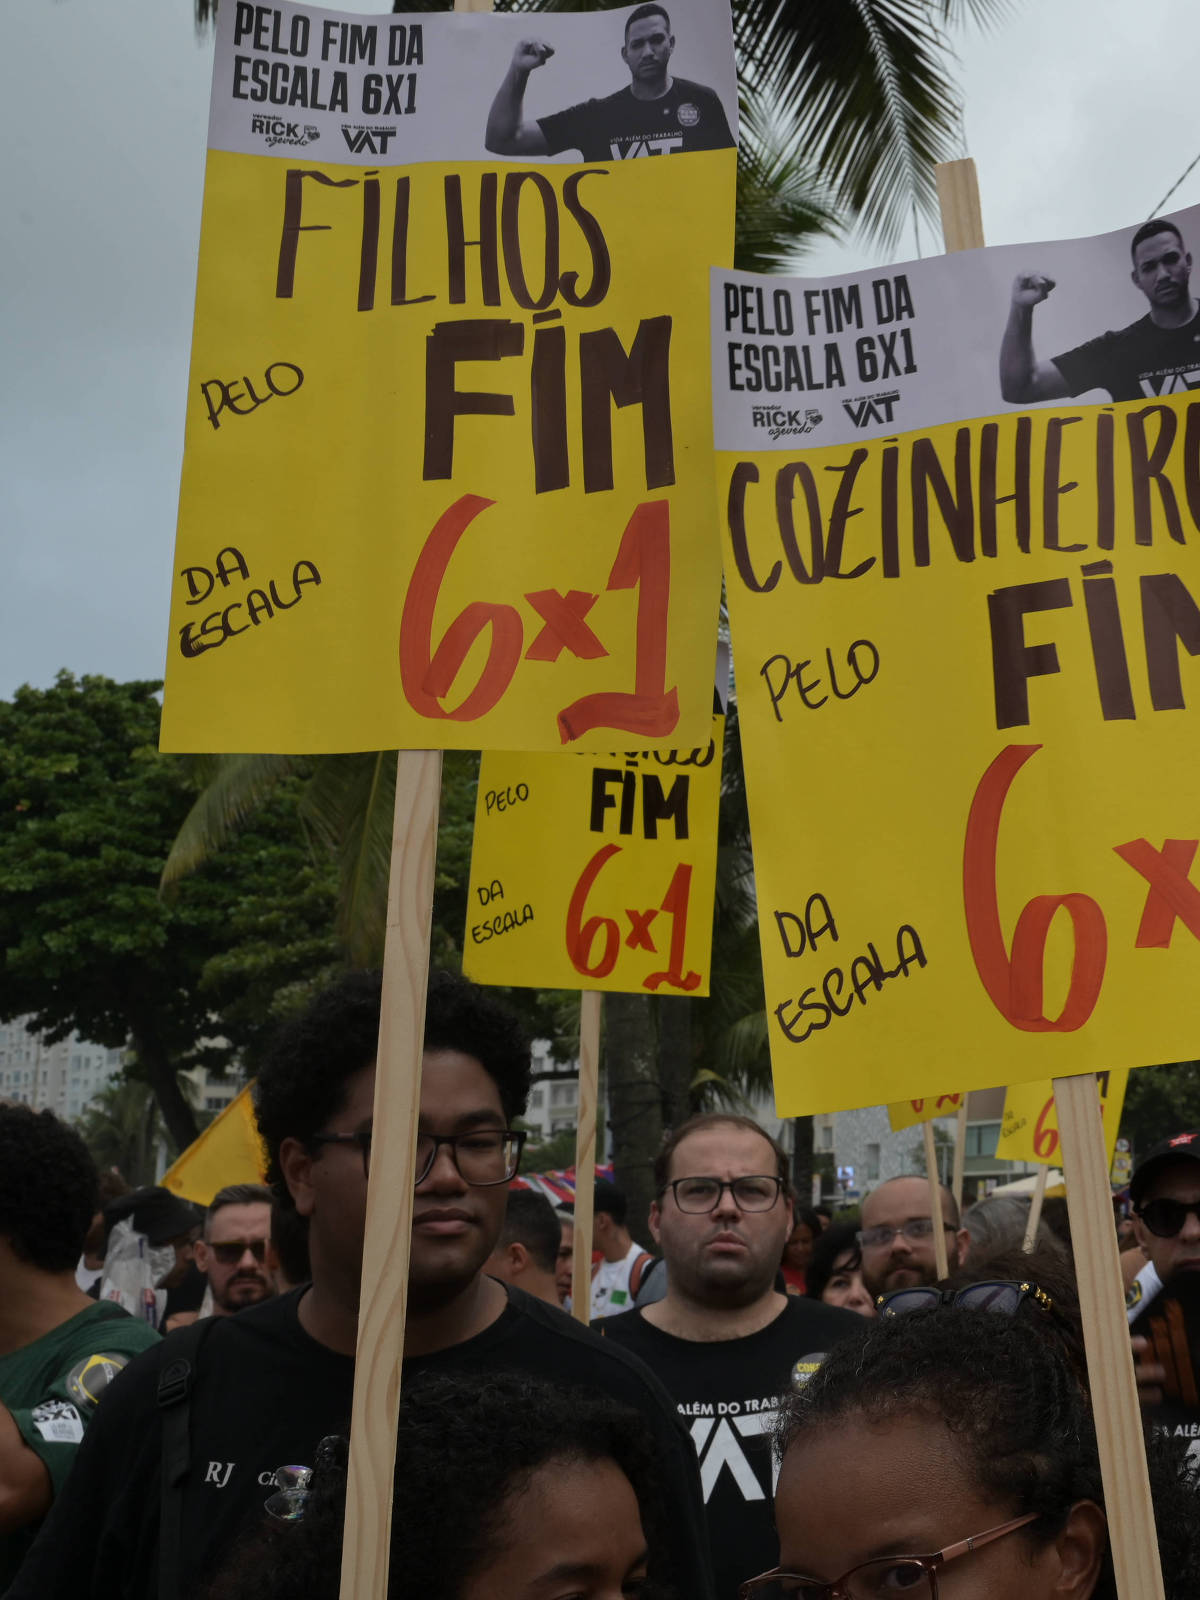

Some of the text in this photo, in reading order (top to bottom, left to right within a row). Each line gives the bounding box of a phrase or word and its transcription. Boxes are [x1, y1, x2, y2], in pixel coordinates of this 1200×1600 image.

[234, 1, 424, 66] PELO FIM DA
[232, 54, 418, 115] ESCALA 6X1
[251, 119, 301, 138] RICK
[341, 129, 397, 154] VAT
[276, 168, 611, 312] FILHOS
[723, 273, 916, 336] PELO FIM DA
[727, 326, 918, 393] ESCALA 6X1
[201, 362, 304, 430] PELO
[422, 307, 675, 495] FIM
[752, 410, 801, 428] RICK
[842, 394, 901, 428] VAT
[768, 421, 813, 441] azevedo
[180, 546, 250, 605] DA
[179, 560, 322, 659] ESCALA
[759, 638, 880, 722] PELO
[485, 783, 529, 816] PELO
[590, 761, 690, 840] FIM
[471, 903, 534, 944] ESCALA
[477, 880, 505, 906] DA
[773, 892, 839, 958] DA
[773, 925, 928, 1043] ESCALA
[718, 1402, 740, 1415] DO
[204, 1461, 236, 1488] RJ
